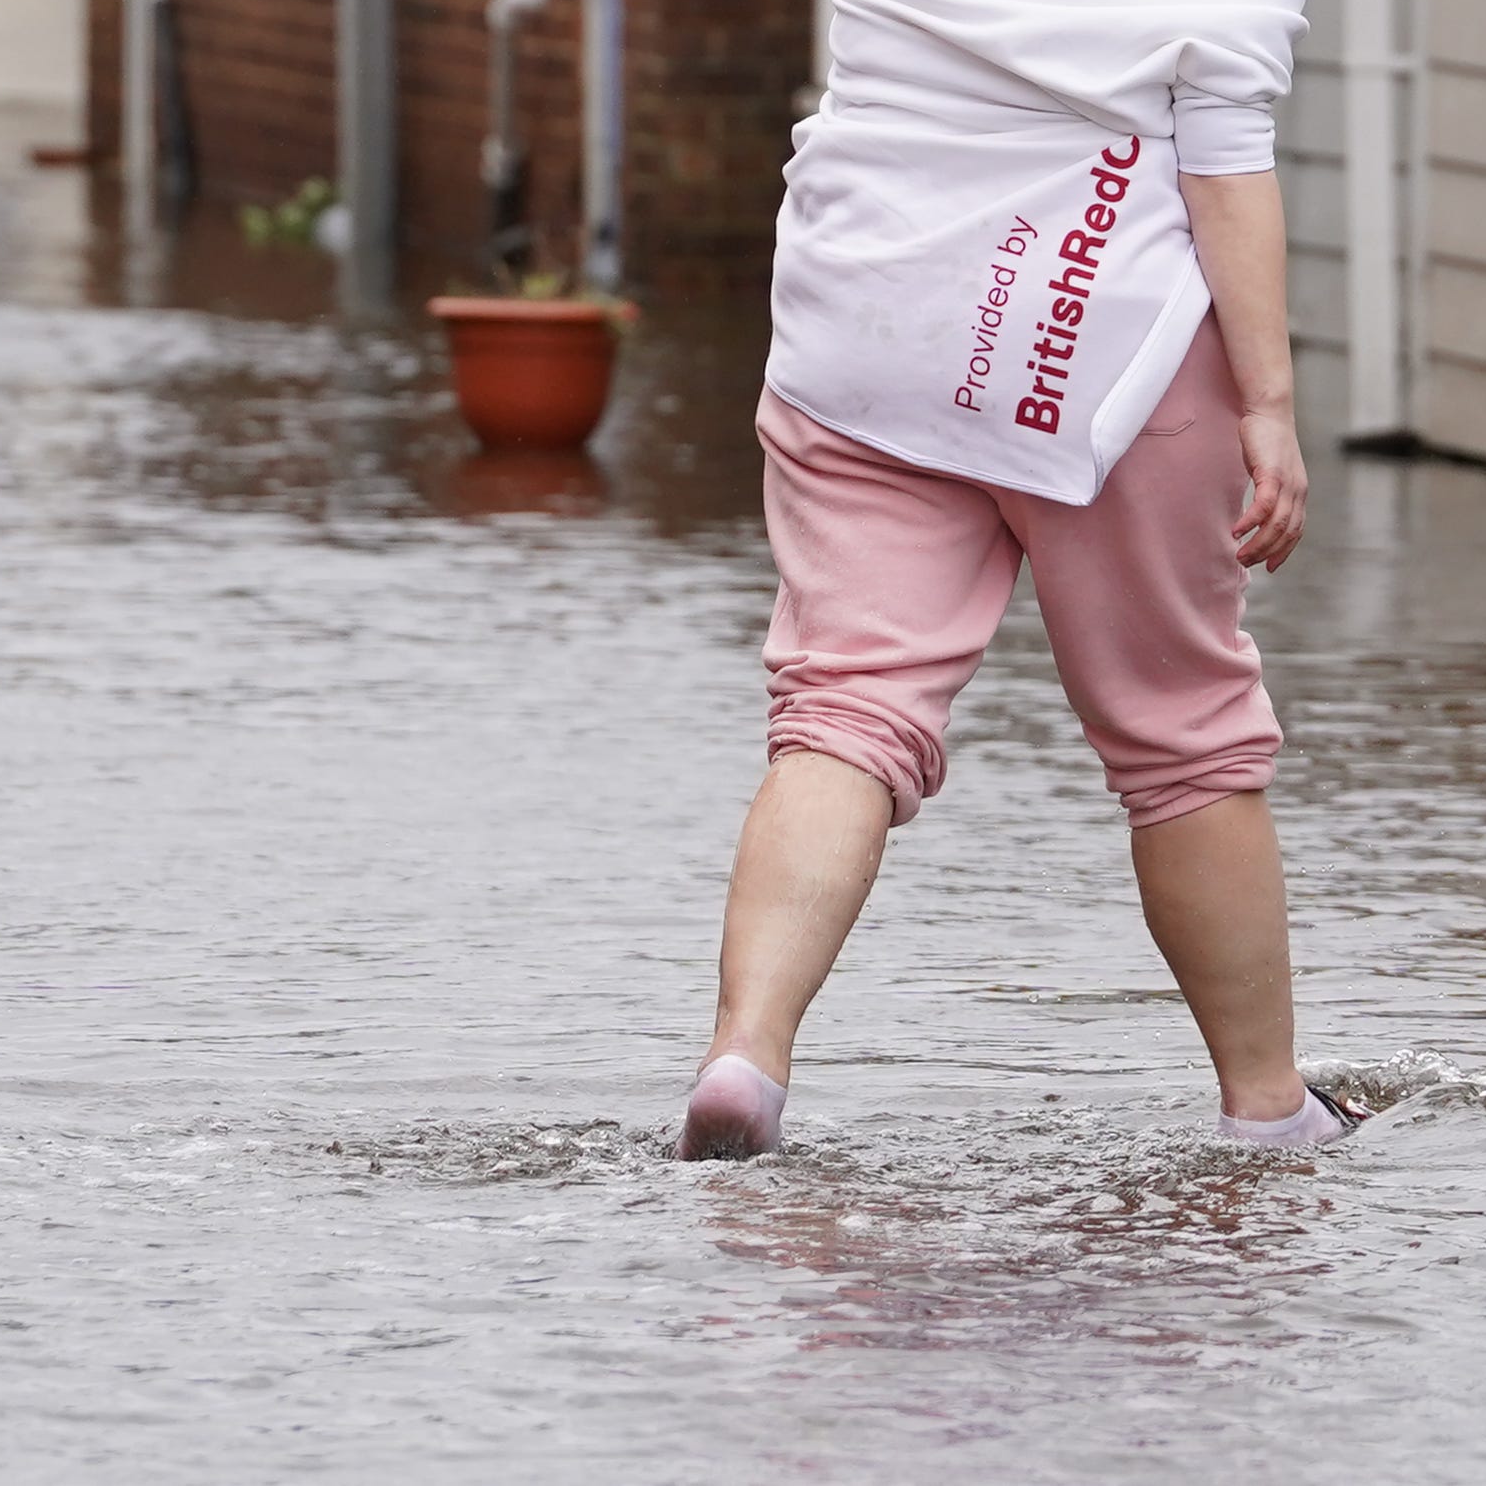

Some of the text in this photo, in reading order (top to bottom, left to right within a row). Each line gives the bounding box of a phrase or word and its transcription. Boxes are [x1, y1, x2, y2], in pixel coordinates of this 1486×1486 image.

[954, 214, 1039, 413] Provided by
[1014, 134, 1141, 436] BritishRedC
